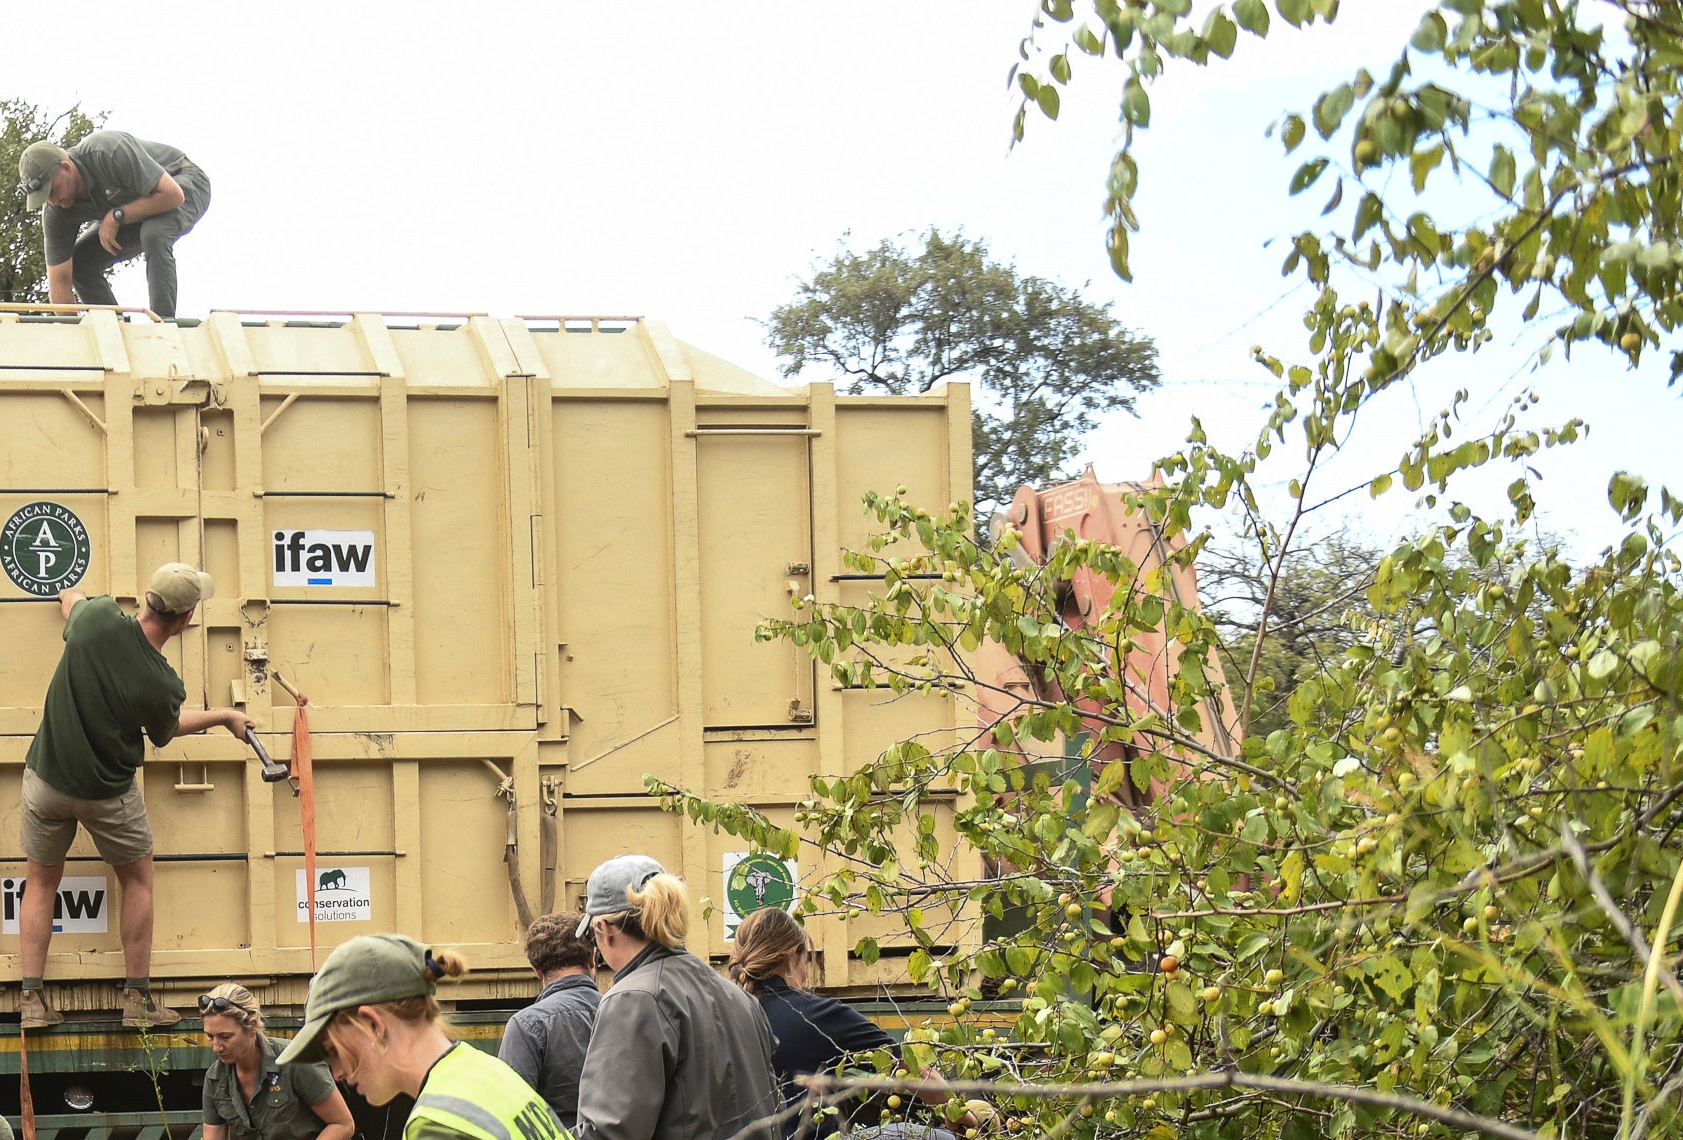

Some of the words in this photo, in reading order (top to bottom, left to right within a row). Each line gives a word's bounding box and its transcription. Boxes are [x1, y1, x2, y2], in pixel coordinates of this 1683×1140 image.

[1044, 487, 1088, 519] FASSI
[4, 504, 51, 539] AFRICAN
[55, 507, 86, 541] PARKS
[32, 520, 59, 547] A
[36, 551, 56, 578] P
[274, 531, 372, 573] ifaw
[3, 555, 49, 593] AFRICAN
[55, 558, 86, 592] PARKS
[298, 897, 370, 909] conservation
